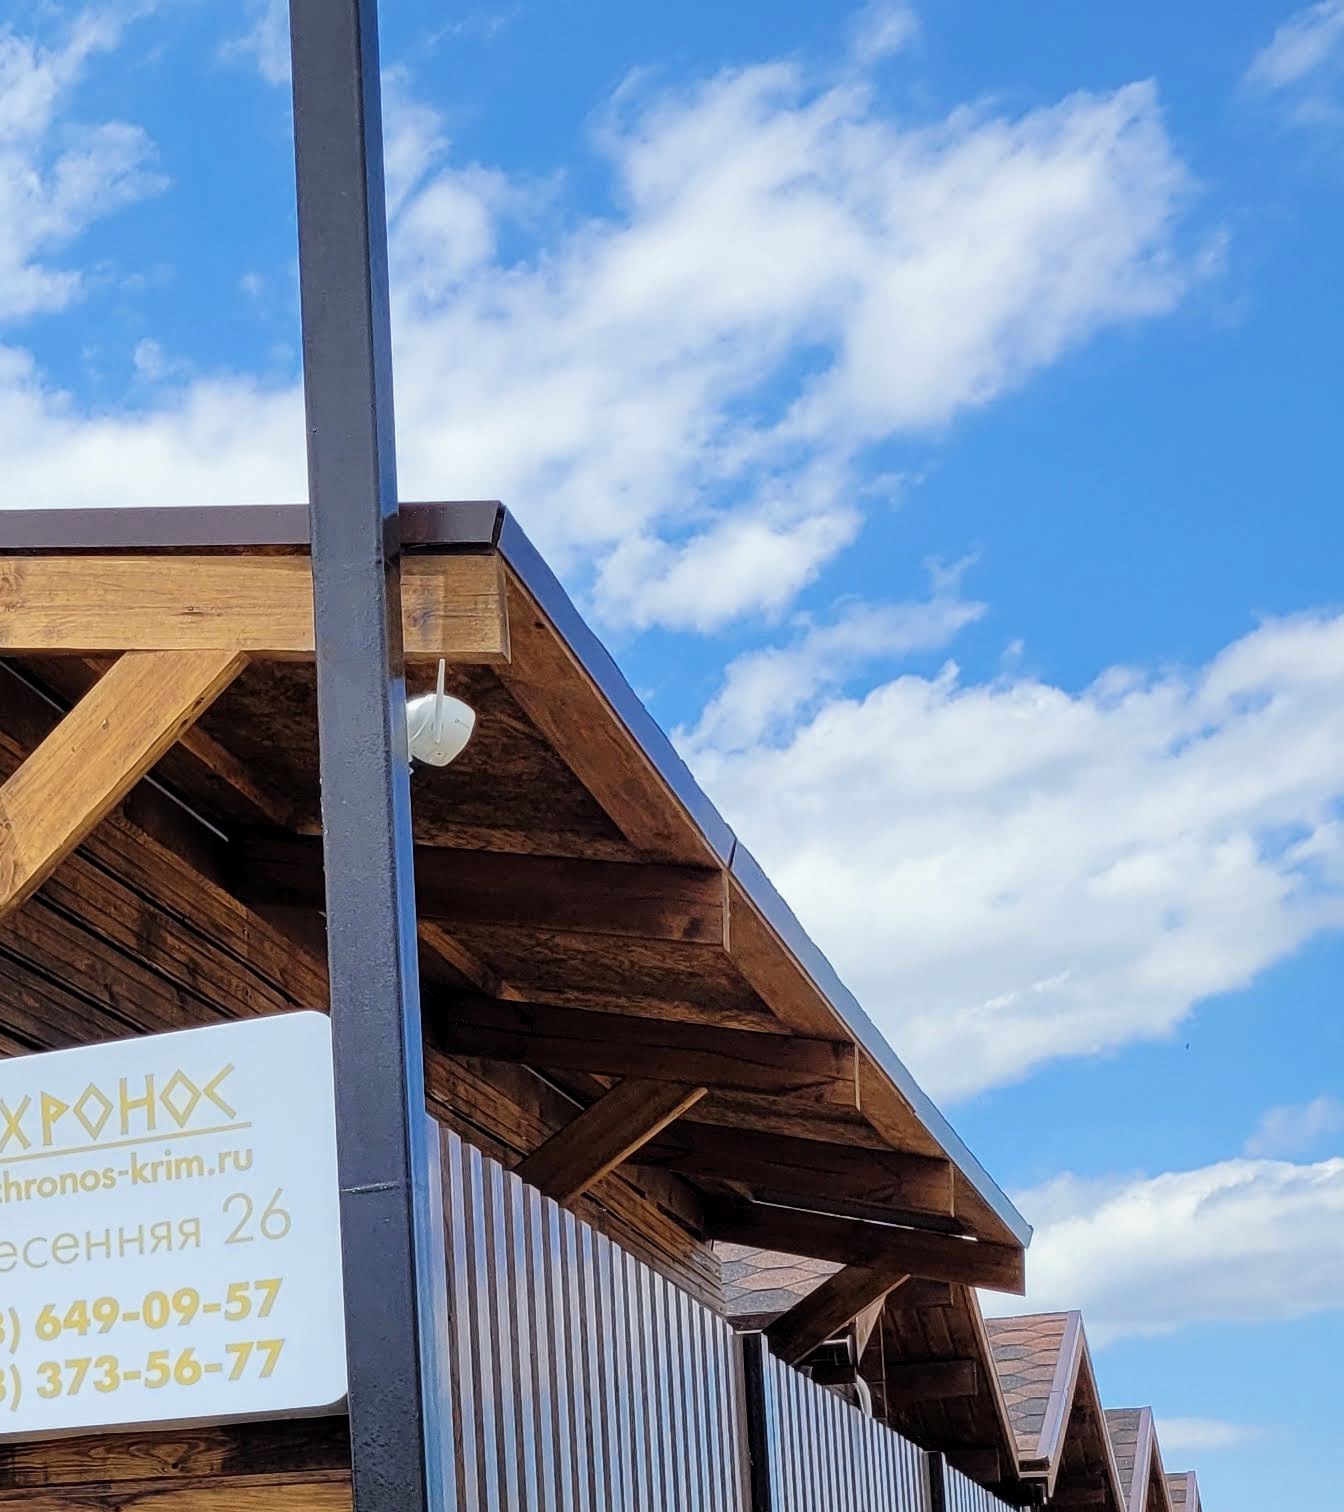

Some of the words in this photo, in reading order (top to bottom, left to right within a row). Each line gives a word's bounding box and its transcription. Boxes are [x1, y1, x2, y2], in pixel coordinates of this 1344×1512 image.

[222, 1188, 291, 1246] 26
[35, 1278, 283, 1342] 649-09-57
[36, 1339, 286, 1399] 373-56-77
